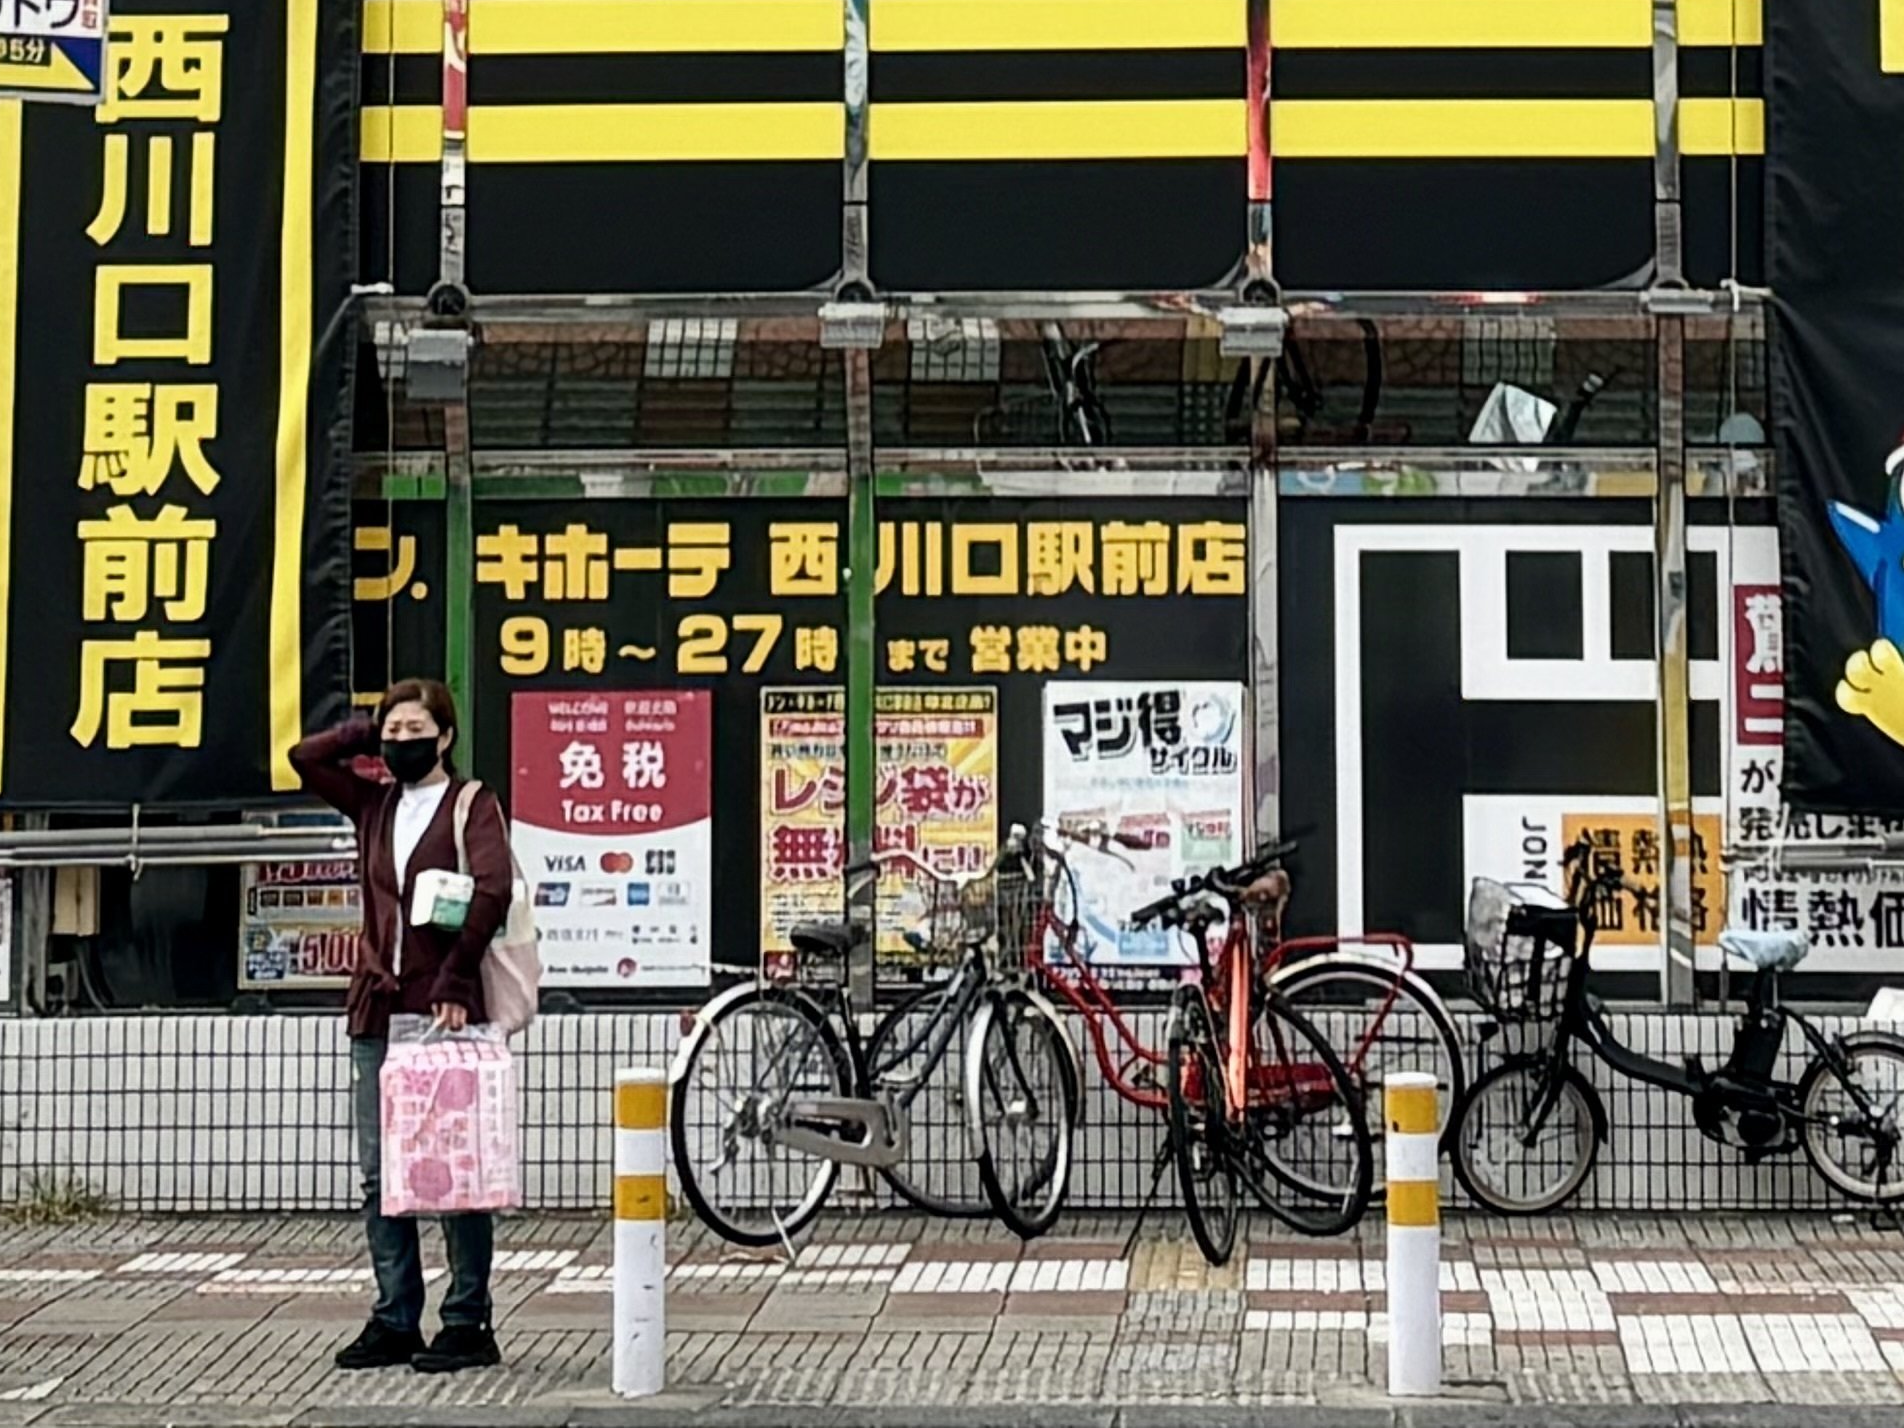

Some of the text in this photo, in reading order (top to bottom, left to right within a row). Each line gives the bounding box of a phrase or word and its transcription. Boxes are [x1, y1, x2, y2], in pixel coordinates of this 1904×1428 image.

[71, 13, 230, 751] 西川口駅前店
[769, 521, 1247, 598] 西川口駅前店
[1053, 689, 1183, 760] マジ得
[559, 740, 667, 789] 免税
[562, 799, 664, 823] Tax Free
[545, 856, 586, 873] VISA
